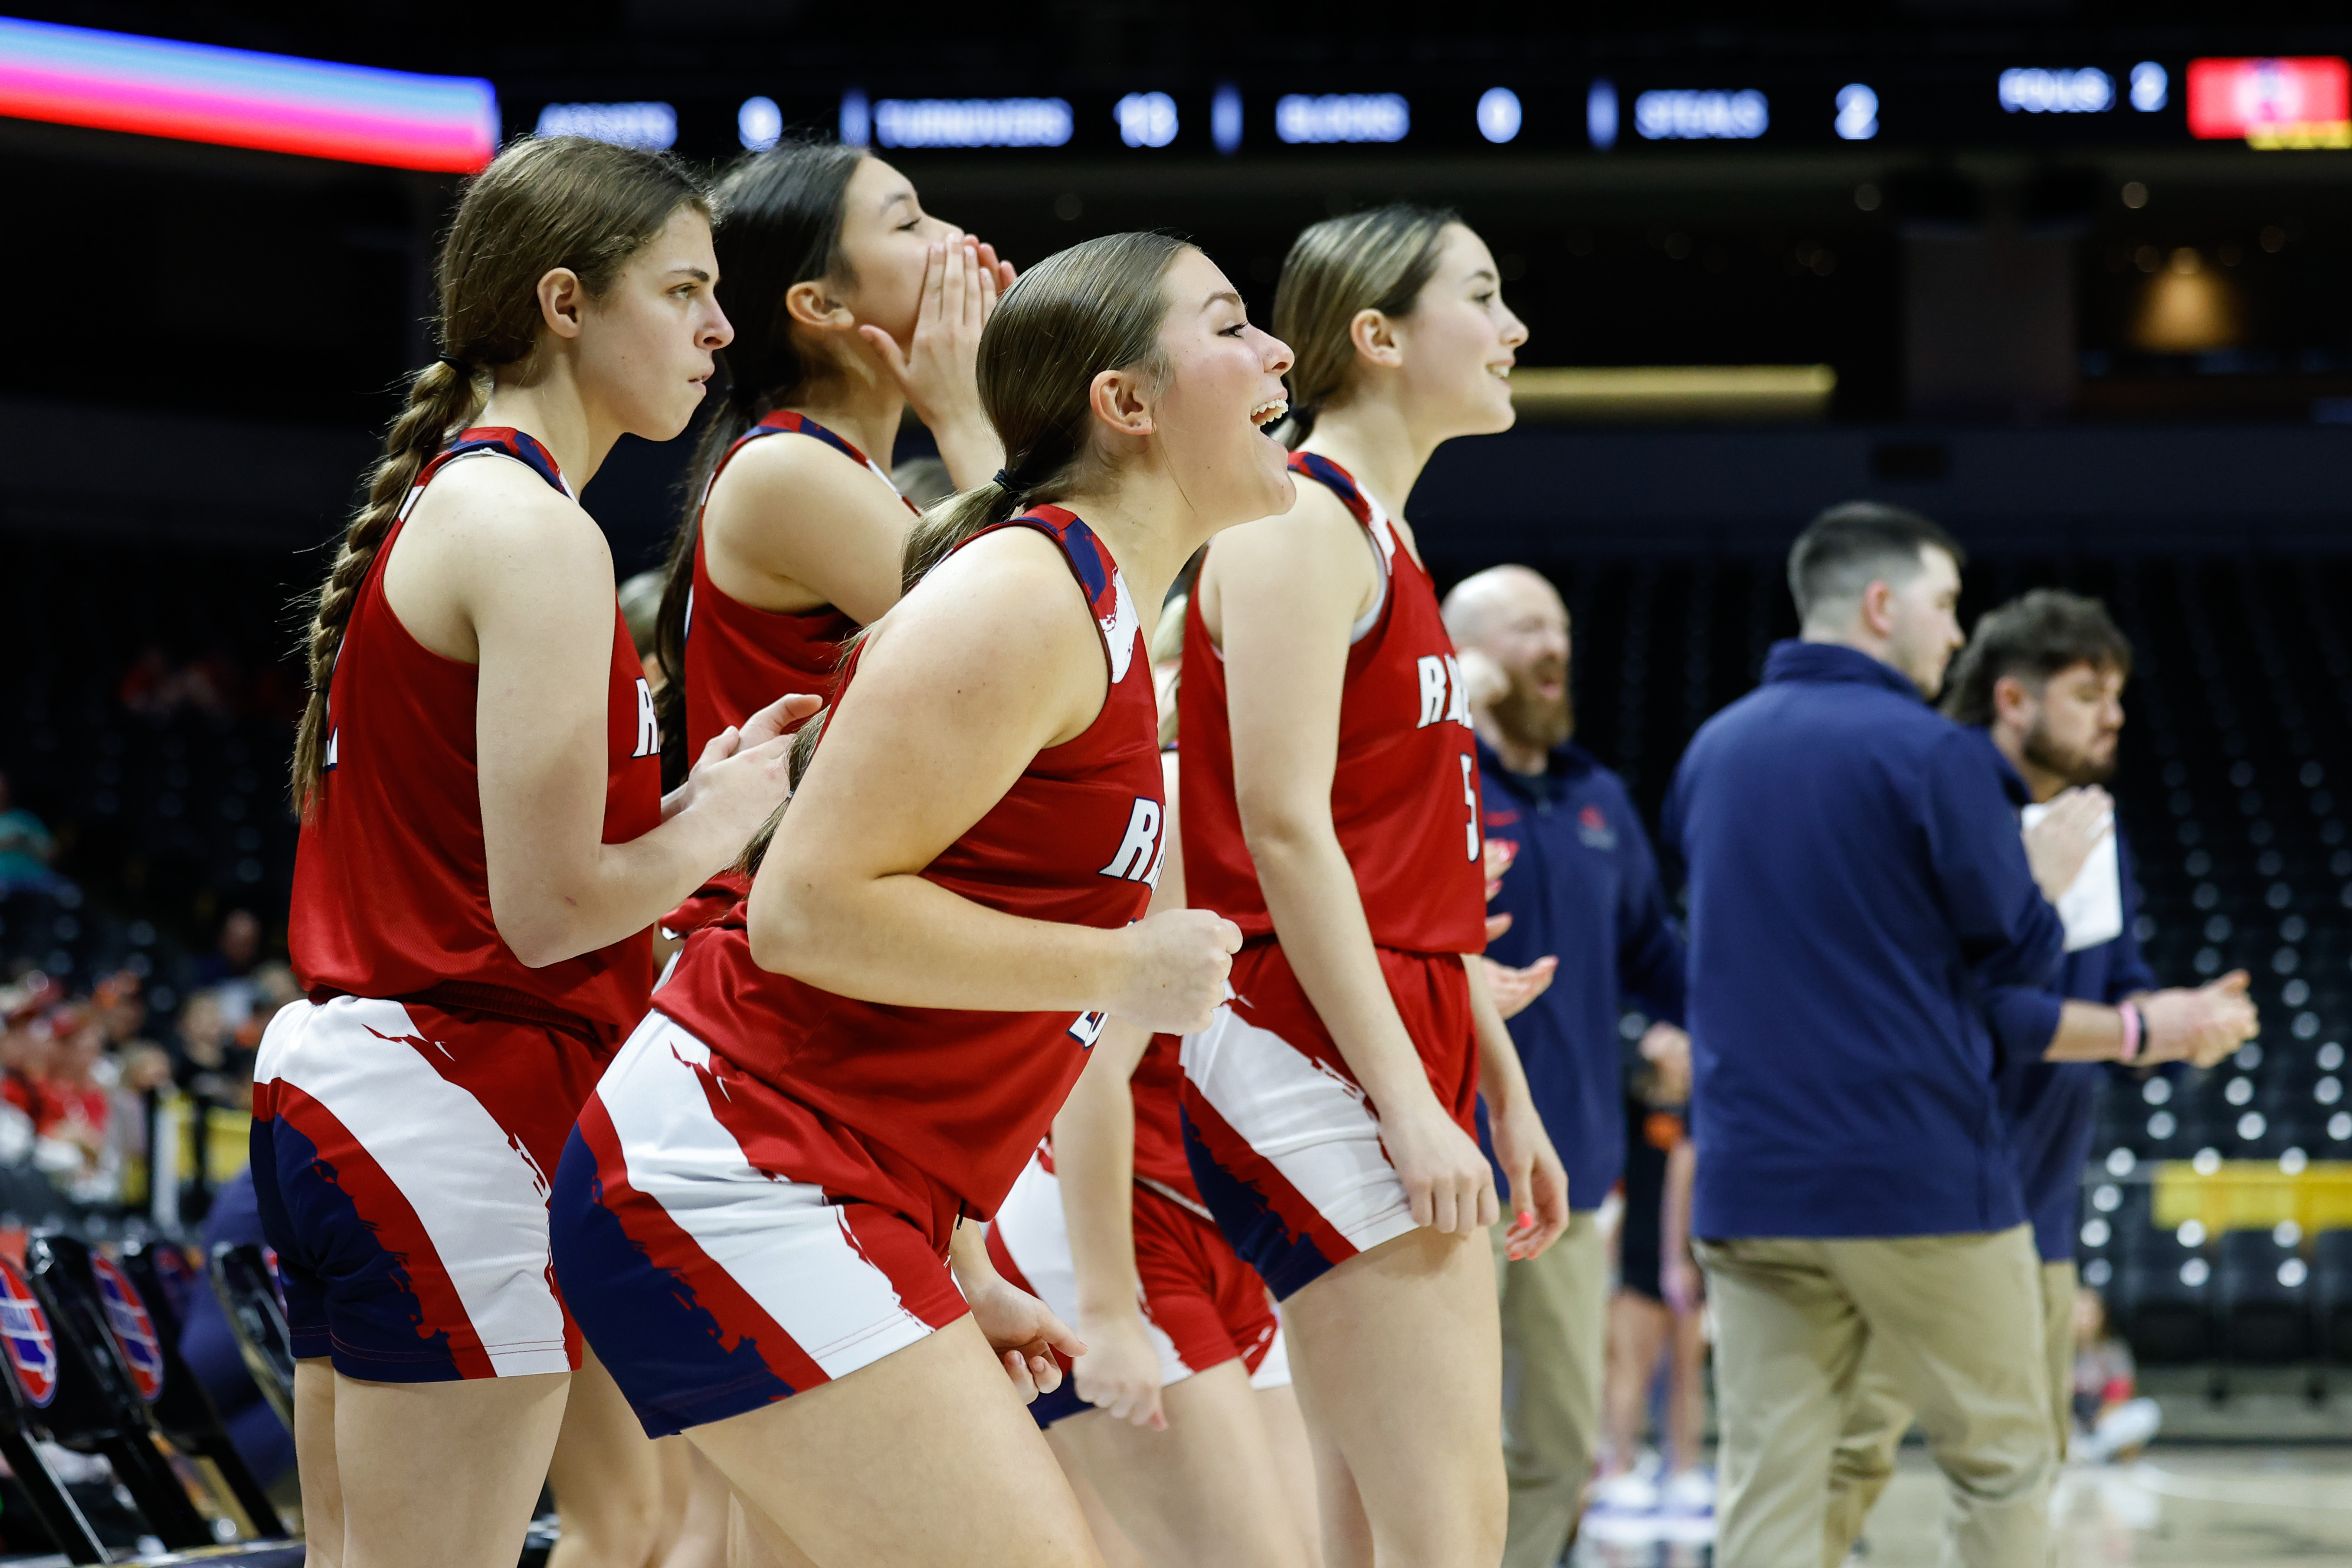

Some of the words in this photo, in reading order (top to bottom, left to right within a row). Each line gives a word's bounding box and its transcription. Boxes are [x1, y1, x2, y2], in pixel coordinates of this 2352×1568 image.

[872, 97, 1073, 148] TURNOVERS
[1634, 88, 1769, 139] STEALS
[1834, 83, 1879, 140] 2
